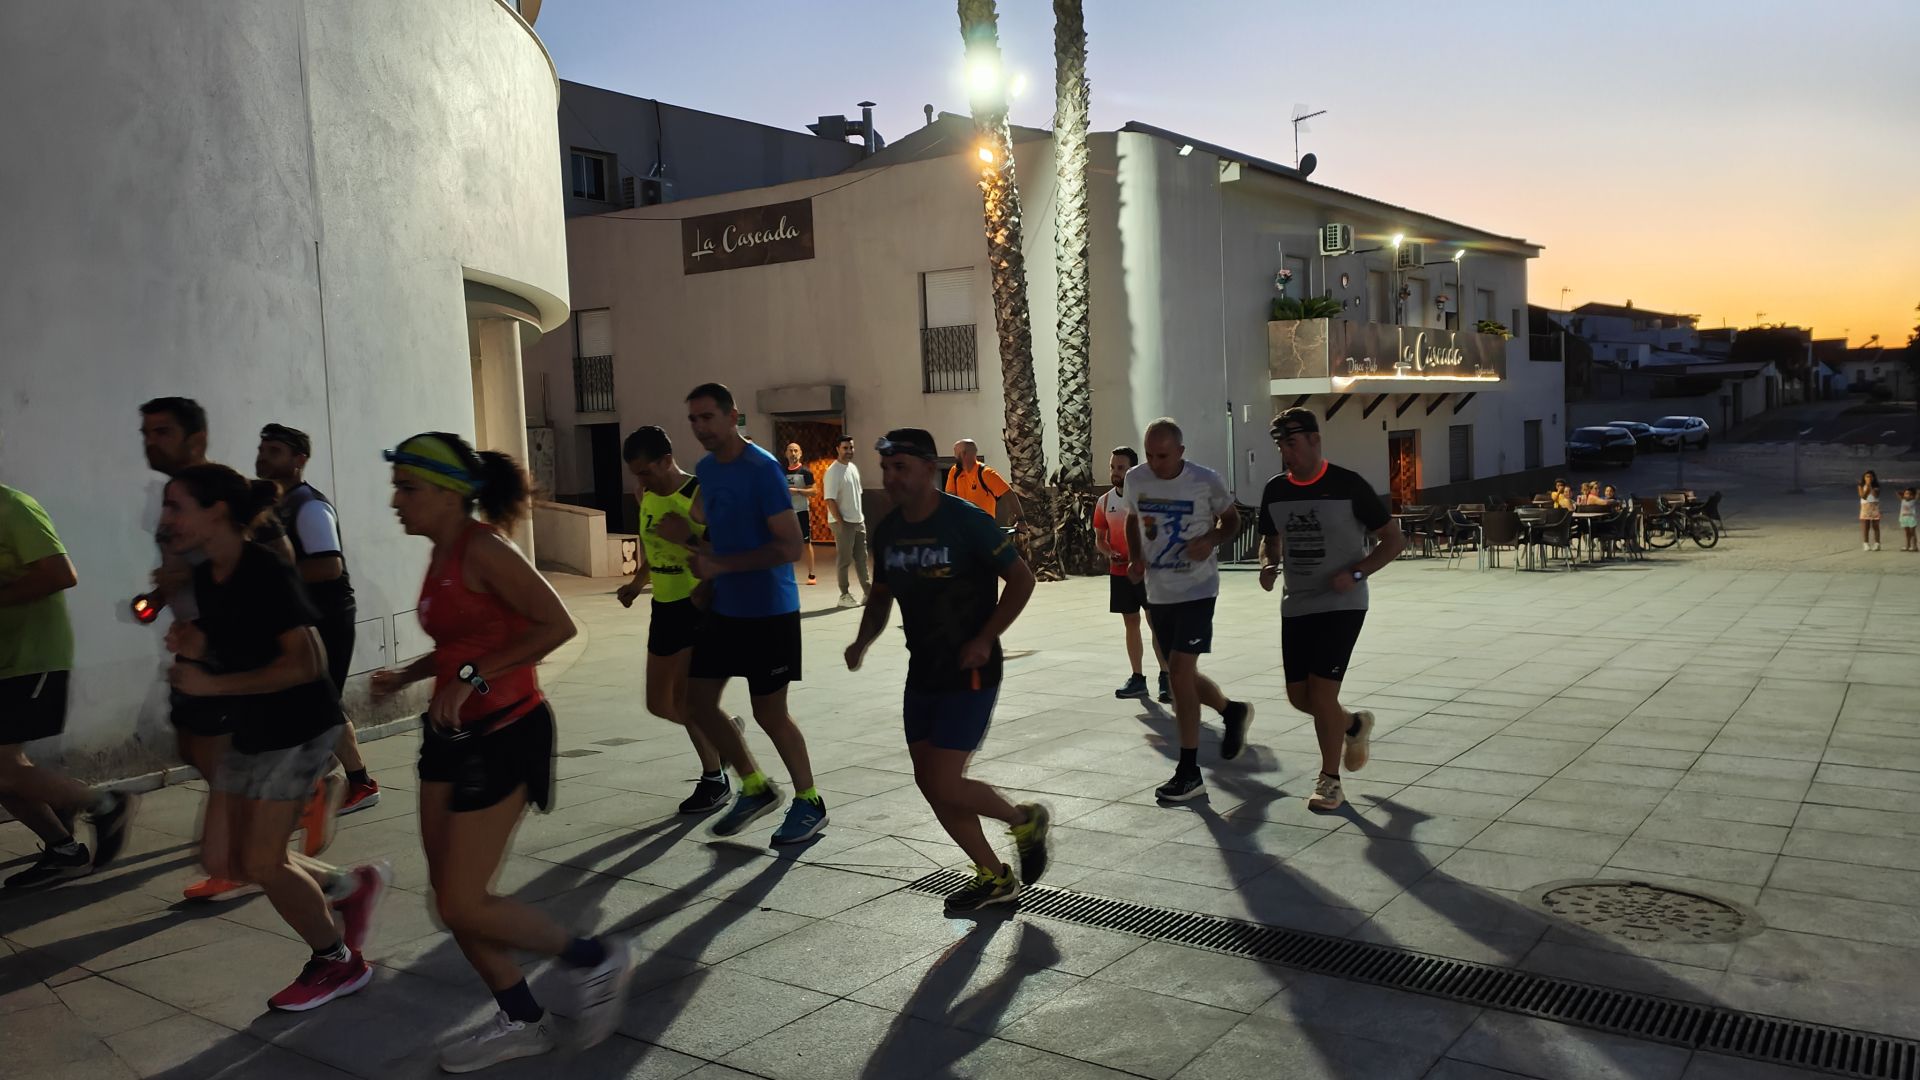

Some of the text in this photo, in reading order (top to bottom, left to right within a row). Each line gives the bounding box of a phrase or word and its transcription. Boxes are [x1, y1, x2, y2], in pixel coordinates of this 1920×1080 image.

[691, 215, 801, 262] La Cascada
[1394, 328, 1462, 375] La Cascada
